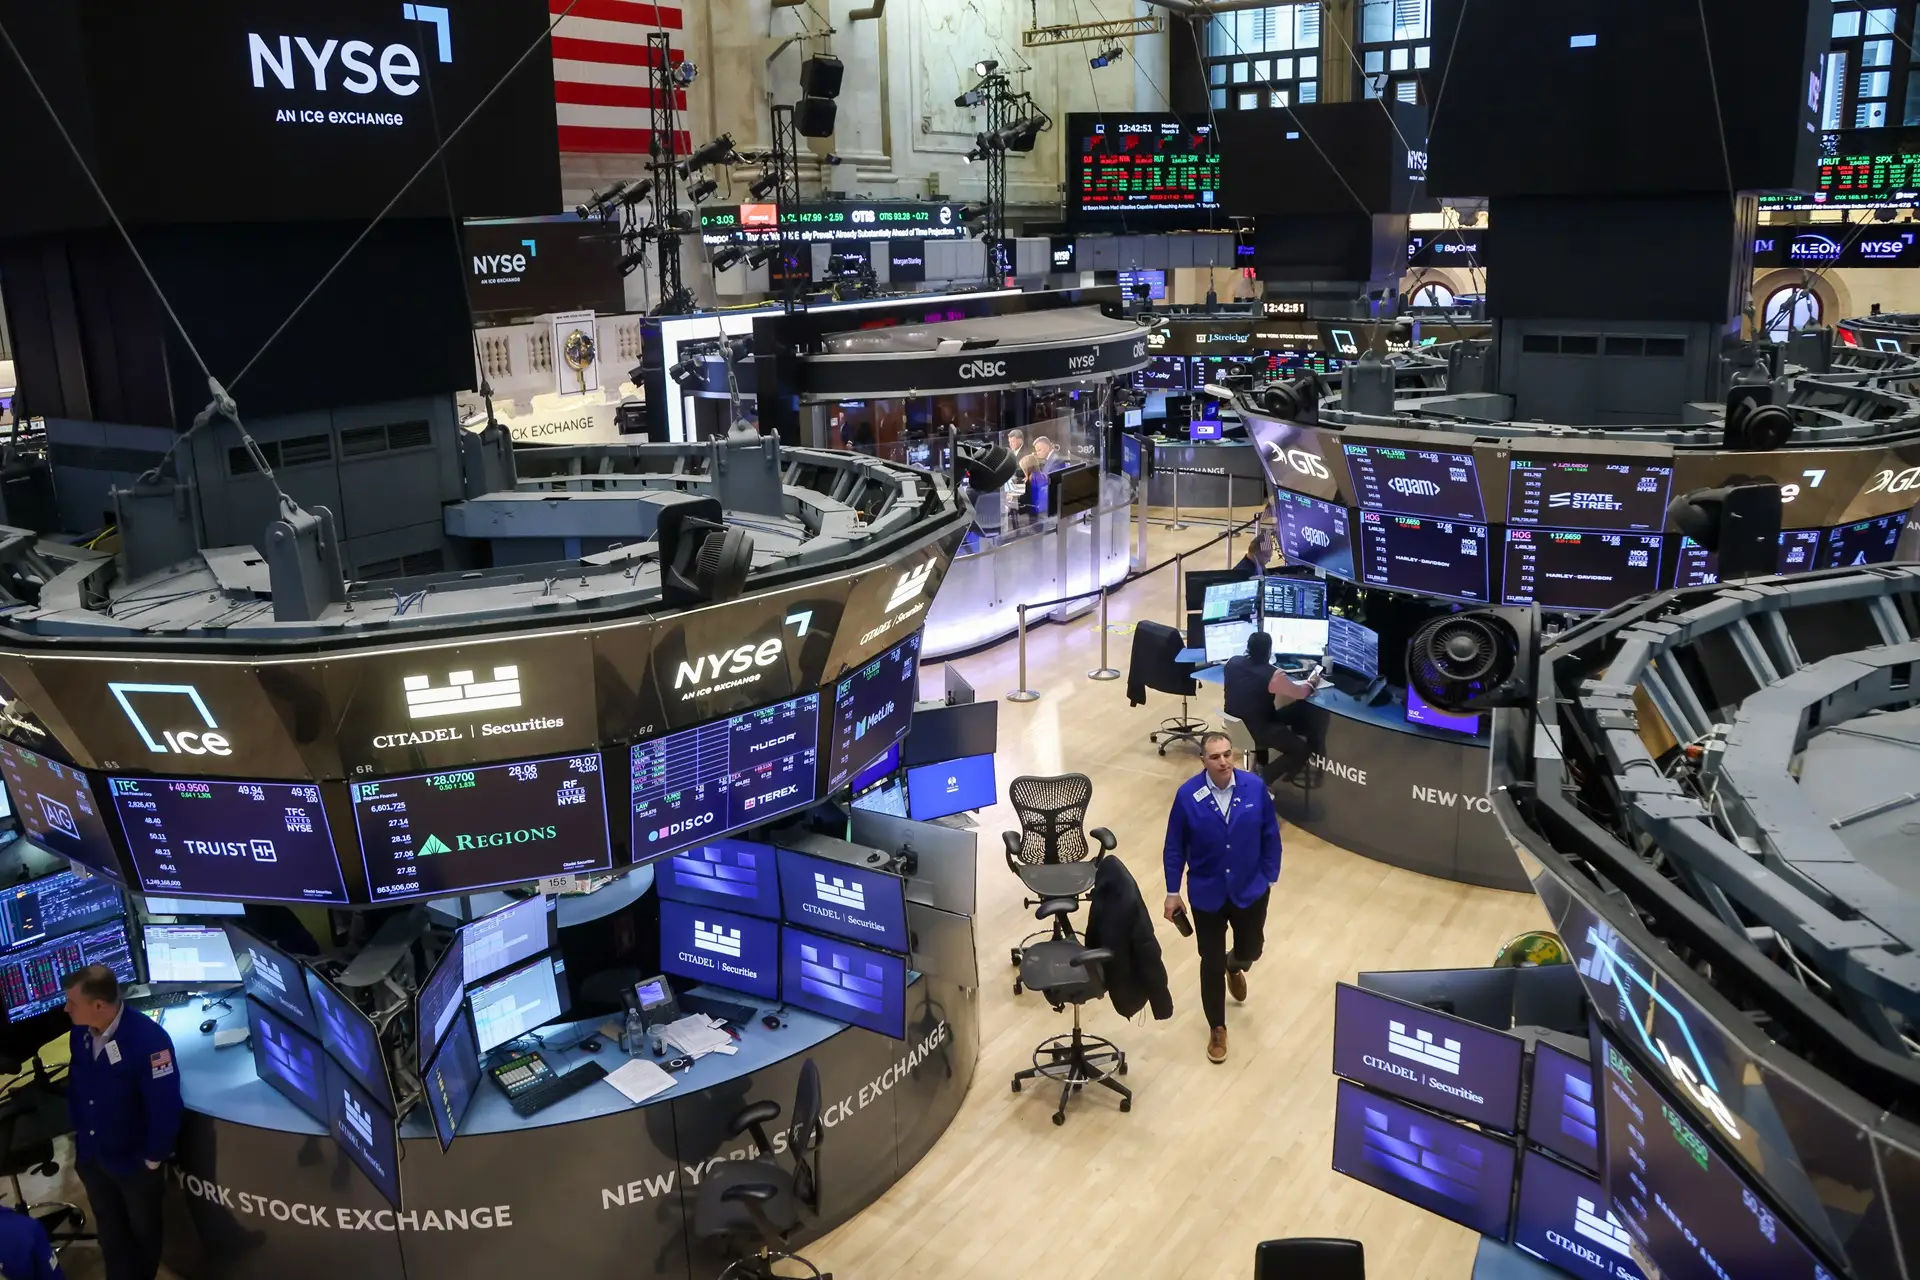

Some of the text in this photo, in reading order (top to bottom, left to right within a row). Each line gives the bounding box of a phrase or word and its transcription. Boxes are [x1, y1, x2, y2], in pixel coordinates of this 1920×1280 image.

[276, 109, 296, 123] AN
[328, 111, 403, 126] EXCHANGE
[1119, 124, 1152, 132] 12:42:51
[1823, 157, 1840, 165] RUT
[717, 215, 734, 224] 3.03
[800, 213, 843, 221] 147.99 2.59
[851, 210, 875, 222] OTIS
[894, 212, 910, 220] 93.28
[915, 212, 928, 220] 0.72
[1792, 243, 1840, 254] KLEON
[1263, 303, 1304, 313] 12:42:51
[959, 360, 1006, 379] CNBC
[531, 417, 594, 437] EXCHANGE
[1349, 446, 1367, 454] EPAM
[1287, 449, 1329, 480] GTS
[1573, 493, 1613, 501] STATE
[1365, 513, 1380, 521] HOG
[1512, 531, 1531, 539] HOG
[839, 680, 851, 693] MET
[681, 692, 696, 701] AN
[867, 700, 894, 730] MetLife
[373, 717, 564, 749] CITADEL Securities
[751, 732, 796, 752] NUCOR
[569, 757, 597, 768] 28.07
[508, 764, 537, 776] 28.06
[578, 765, 598, 773] 4,100
[1308, 753, 1367, 785] CHANGE
[434, 772, 475, 786] 28.0700
[518, 773, 538, 781] 1,700
[116, 781, 139, 791] TFC
[175, 783, 209, 792] 49.9500
[563, 780, 577, 789] RF
[238, 785, 263, 795] 49.94
[291, 787, 316, 796] 49.95
[362, 784, 380, 796] RF
[557, 789, 585, 797] LISTED
[558, 796, 586, 806] NYSE
[1412, 785, 1497, 815] NEW YO
[371, 802, 406, 812] 6,601,725
[636, 802, 648, 810] LAW
[46, 803, 72, 830] AIG
[285, 807, 306, 816] TFC
[388, 818, 408, 827] 27.14
[670, 812, 714, 835] DISCO
[286, 824, 313, 832] NYSE
[391, 835, 411, 843] 28.16
[184, 840, 247, 857] TRUIST
[394, 850, 414, 859] 27.06
[397, 866, 416, 875] 27.82
[548, 877, 567, 887] 155
[802, 903, 885, 932] CITADEL Securities
[679, 952, 757, 979] CITADEL Securities
[1609, 1048, 1633, 1083] BAC
[1363, 1054, 1484, 1105] CITADEL Securities
[601, 1170, 676, 1210] NEW
[858, 1020, 946, 1109] EXCHANGE
[173, 1163, 513, 1231] YORK STOCK EXCHANGE
[1546, 1230, 1604, 1269] CITADEL
